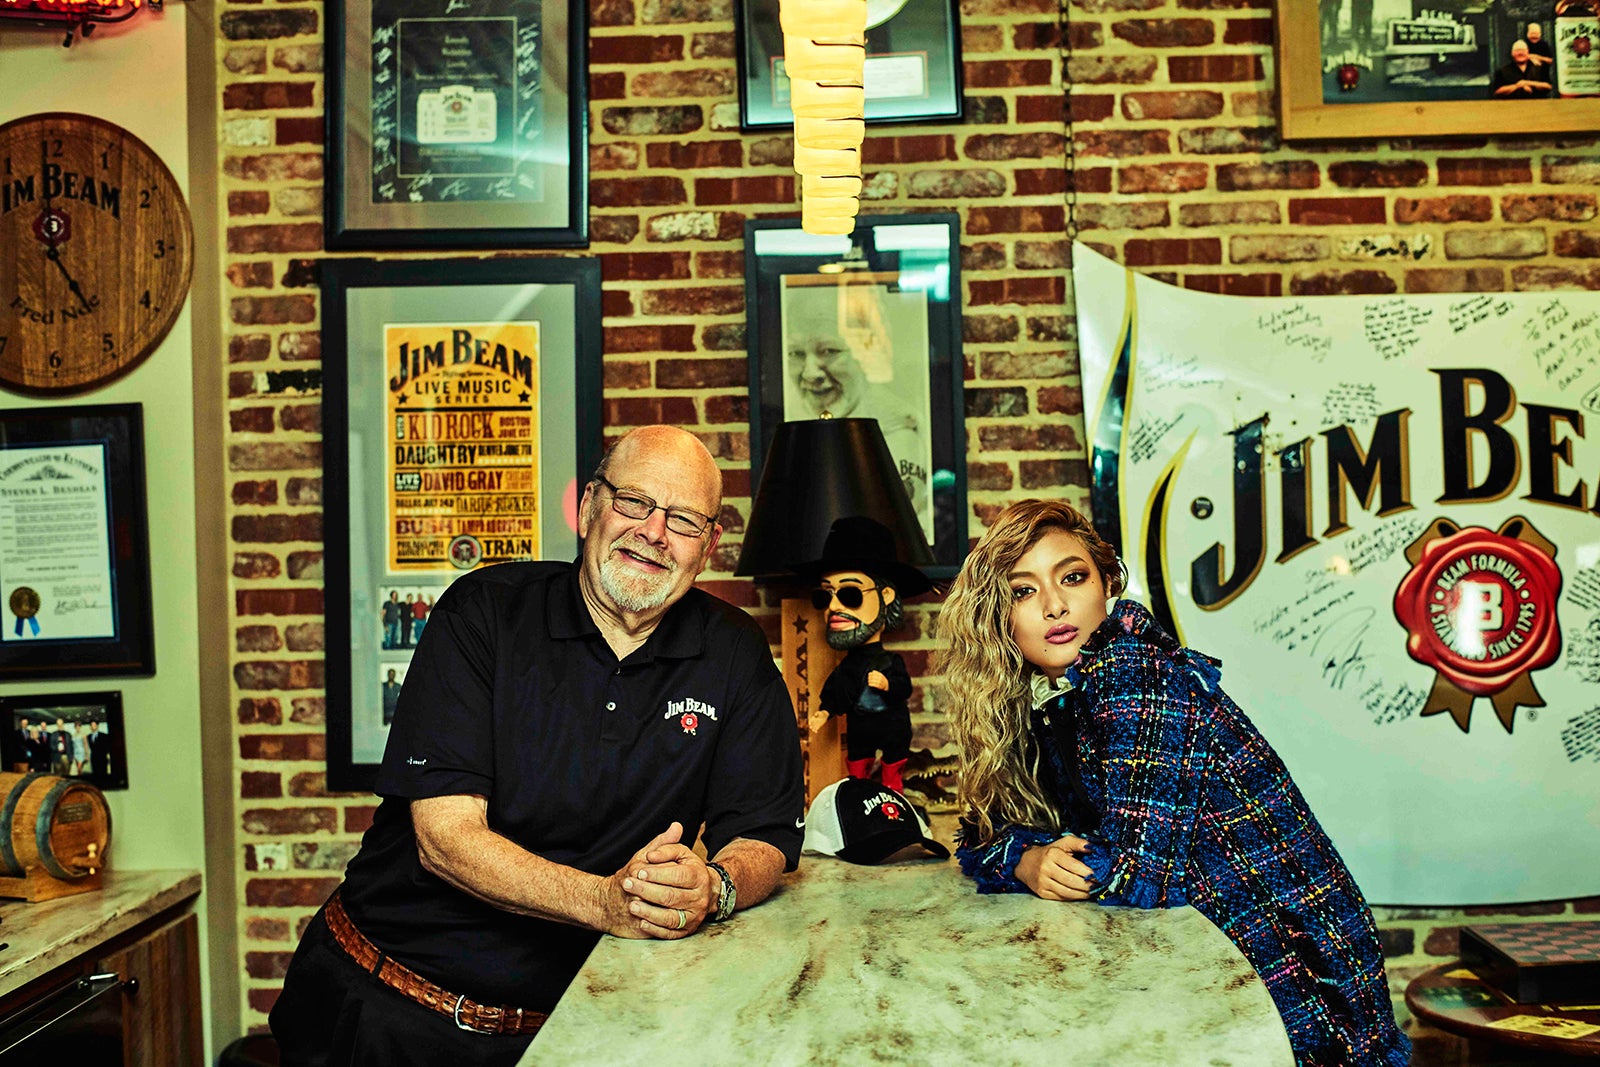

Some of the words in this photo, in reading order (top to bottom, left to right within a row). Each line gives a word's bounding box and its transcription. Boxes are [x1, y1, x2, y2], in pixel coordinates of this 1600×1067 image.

[42, 139, 63, 158] 12
[0, 174, 35, 215] IM
[43, 163, 121, 220] BEAM
[139, 189, 152, 209] 2
[153, 239, 166, 259] 3
[138, 289, 151, 309] 4
[9, 295, 54, 325] Fred
[102, 333, 114, 352] 5
[50, 350, 62, 368] 6
[390, 340, 446, 393] JIM
[452, 329, 533, 391] BEAM
[415, 381, 450, 395] LIVE
[458, 380, 512, 394] MUSIC
[436, 395, 490, 404] SERIES
[408, 413, 442, 441] KID
[445, 411, 495, 441] ROCK
[395, 444, 477, 465] DAUGHTRY
[424, 472, 465, 491] DAVID
[467, 470, 503, 490] GRAY
[1191, 407, 1416, 611] JIM
[1427, 368, 1600, 516] BE
[456, 497, 493, 513] DARIUS
[1436, 558, 1471, 591] BEAM
[1470, 554, 1527, 591] FORMULA
[1487, 629, 1524, 660] SINCE
[1515, 602, 1536, 633] 1795
[664, 700, 685, 720] JIM
[685, 697, 718, 721] BEAM
[863, 795, 882, 816] JIM
